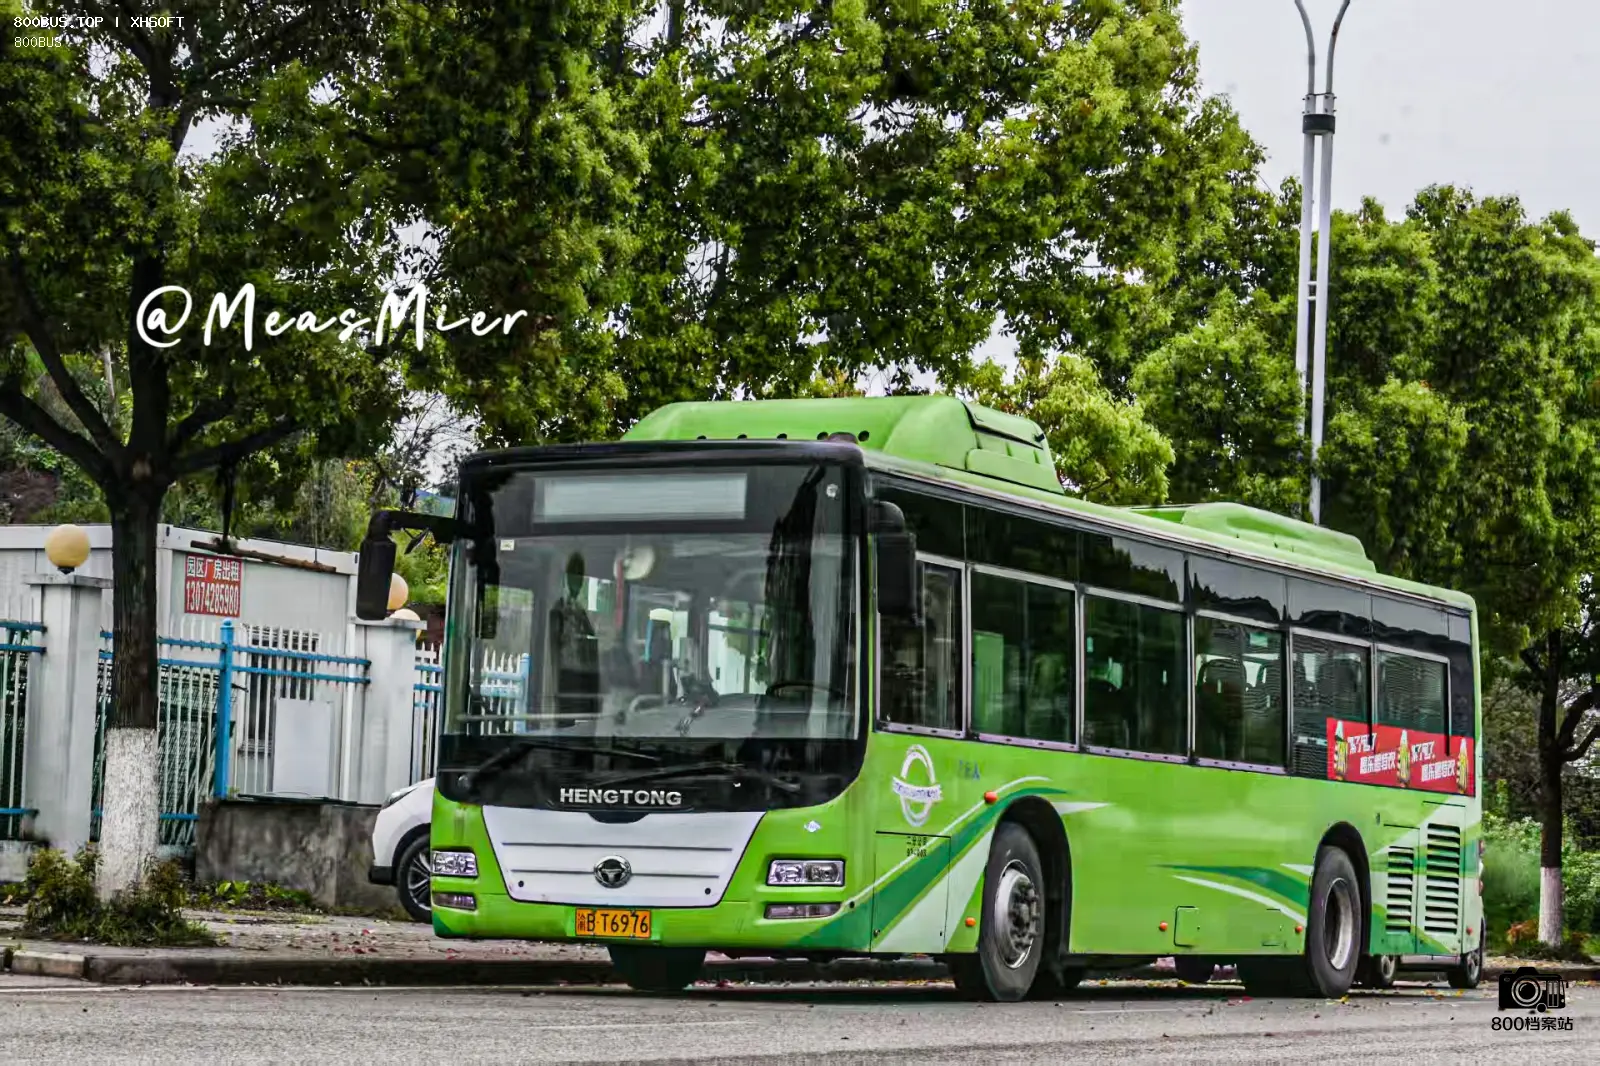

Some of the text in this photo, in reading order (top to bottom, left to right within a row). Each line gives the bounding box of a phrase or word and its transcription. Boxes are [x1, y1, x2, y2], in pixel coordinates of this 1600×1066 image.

[186, 556, 240, 581] 园区厂房出租
[186, 580, 239, 615] 13074285980
[559, 788, 682, 806] HENGTONG
